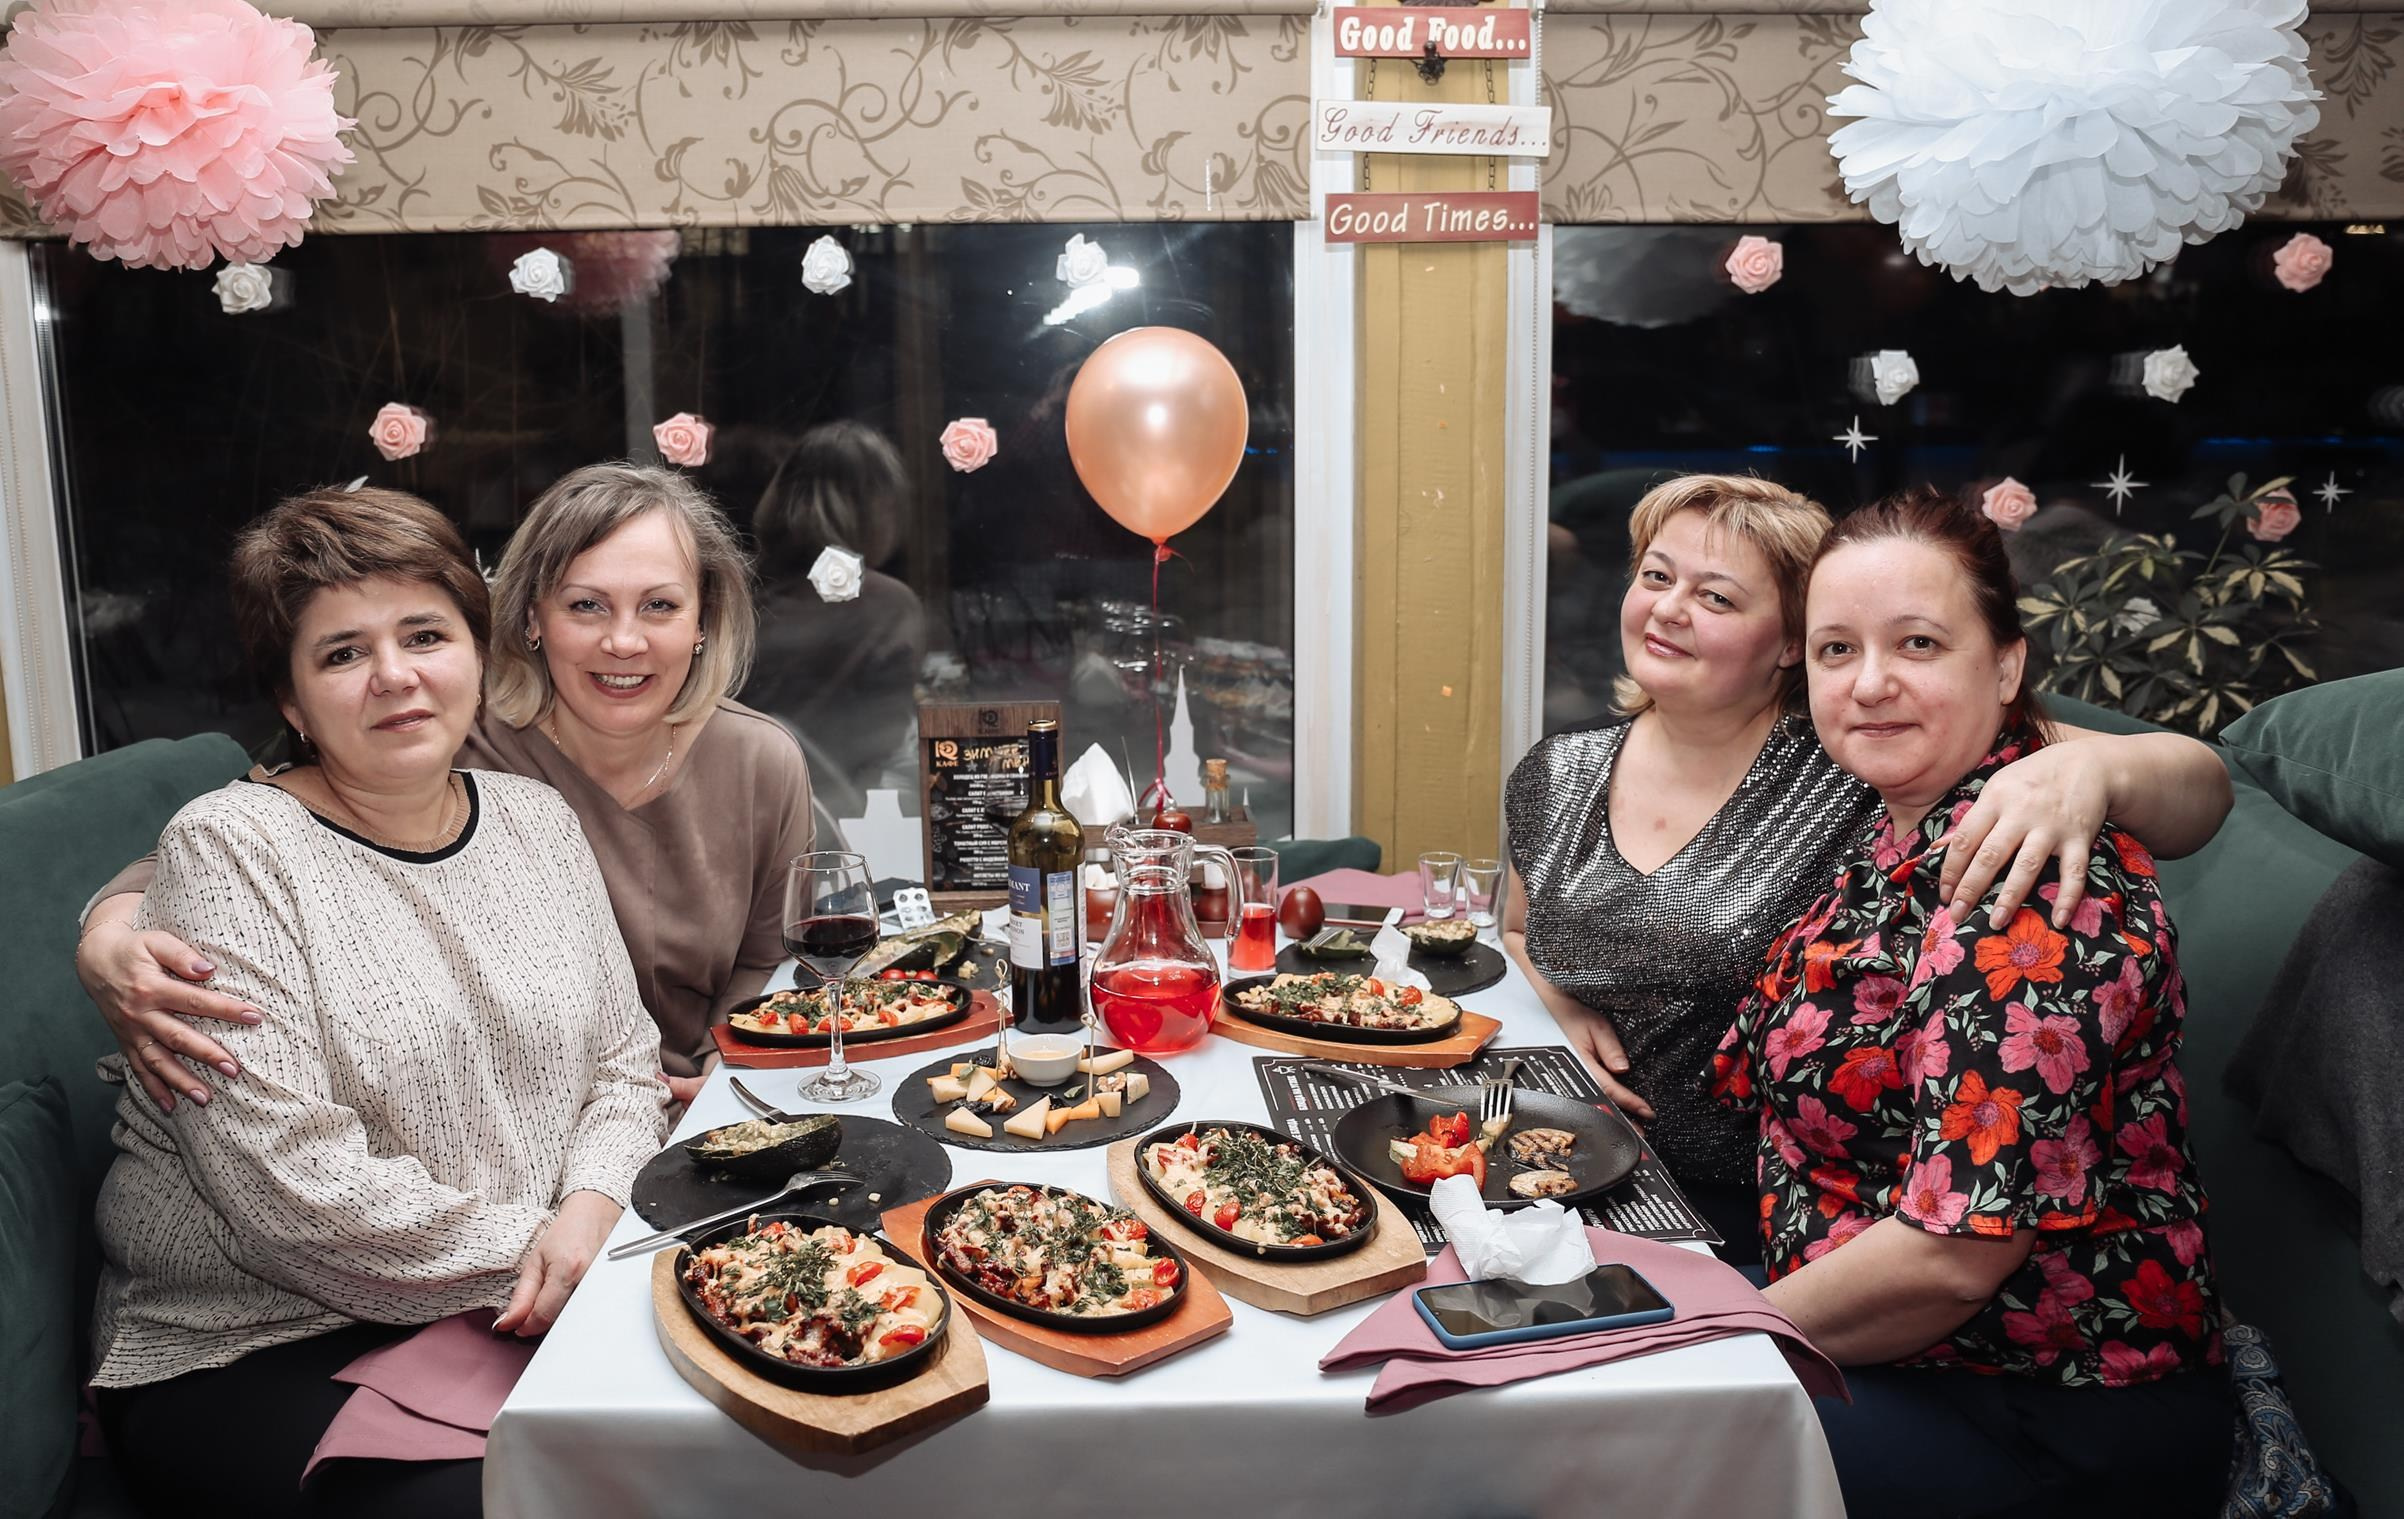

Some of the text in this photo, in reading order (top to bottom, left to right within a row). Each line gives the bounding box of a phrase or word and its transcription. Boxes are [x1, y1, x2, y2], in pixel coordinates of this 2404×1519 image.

[1340, 15, 1526, 51] Good Food...
[1321, 107, 1546, 147] Good Friends...
[1330, 202, 1534, 235] Good Times...
[1002, 755, 1029, 770] МЕН
